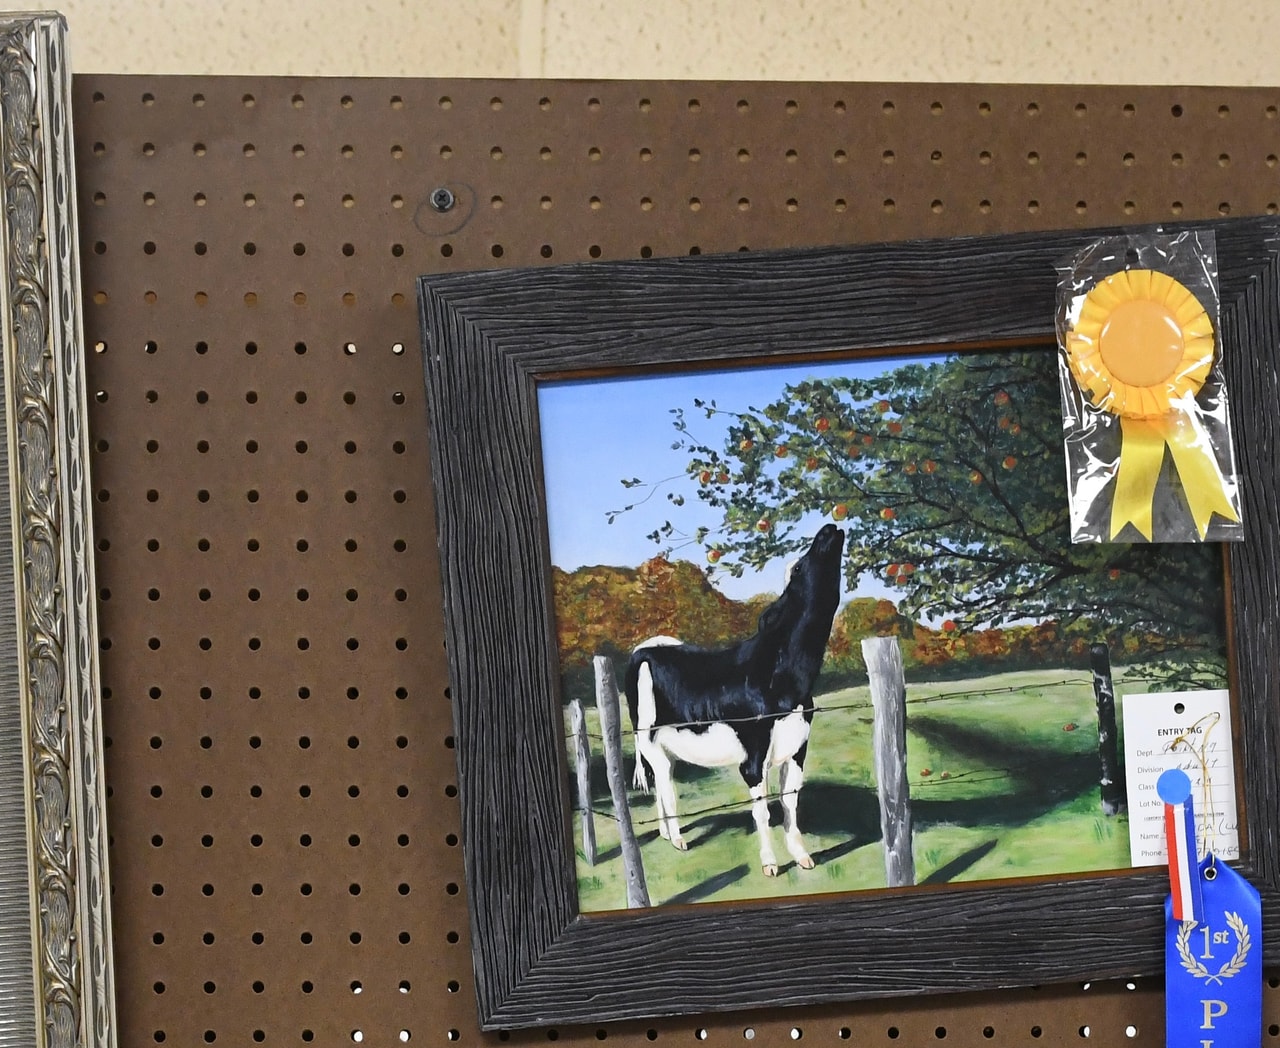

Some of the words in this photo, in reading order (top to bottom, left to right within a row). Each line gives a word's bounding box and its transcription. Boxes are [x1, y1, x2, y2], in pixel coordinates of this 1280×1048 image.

[1157, 728, 1184, 737] ENTRY
[1186, 727, 1202, 735] TAG
[1137, 766, 1164, 774] Division
[1199, 925, 1229, 959] 1st
